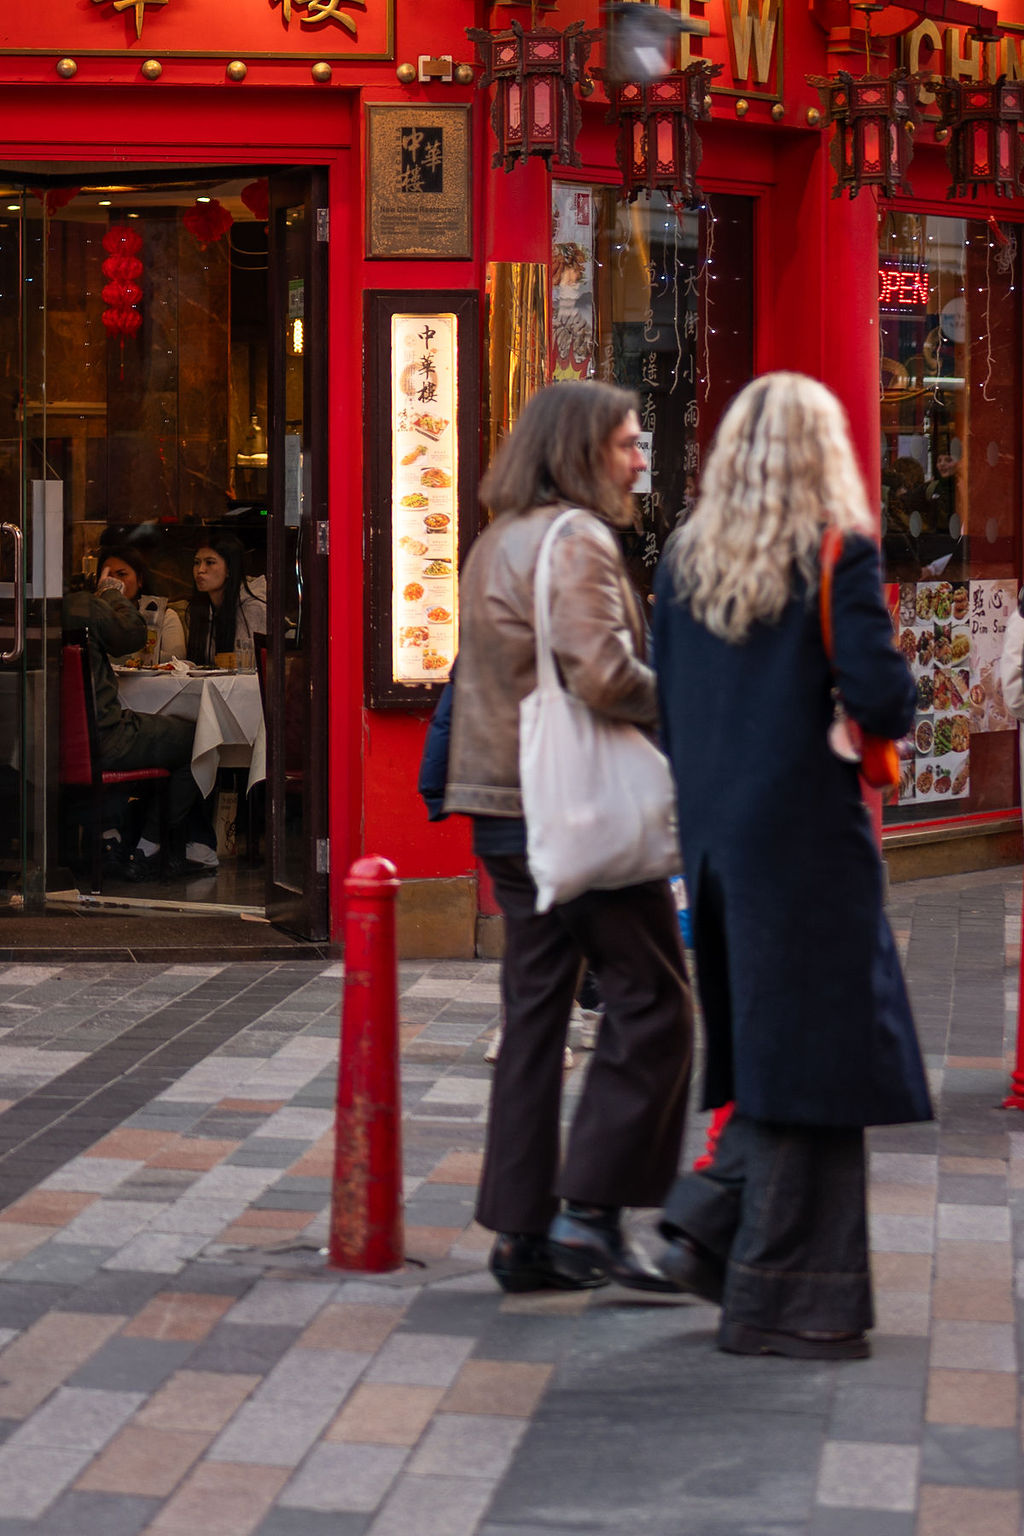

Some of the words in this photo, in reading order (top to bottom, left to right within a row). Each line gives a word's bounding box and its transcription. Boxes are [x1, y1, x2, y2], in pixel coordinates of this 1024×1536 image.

[417, 325, 438, 403] 中華樓
[972, 620, 988, 635] Dim
